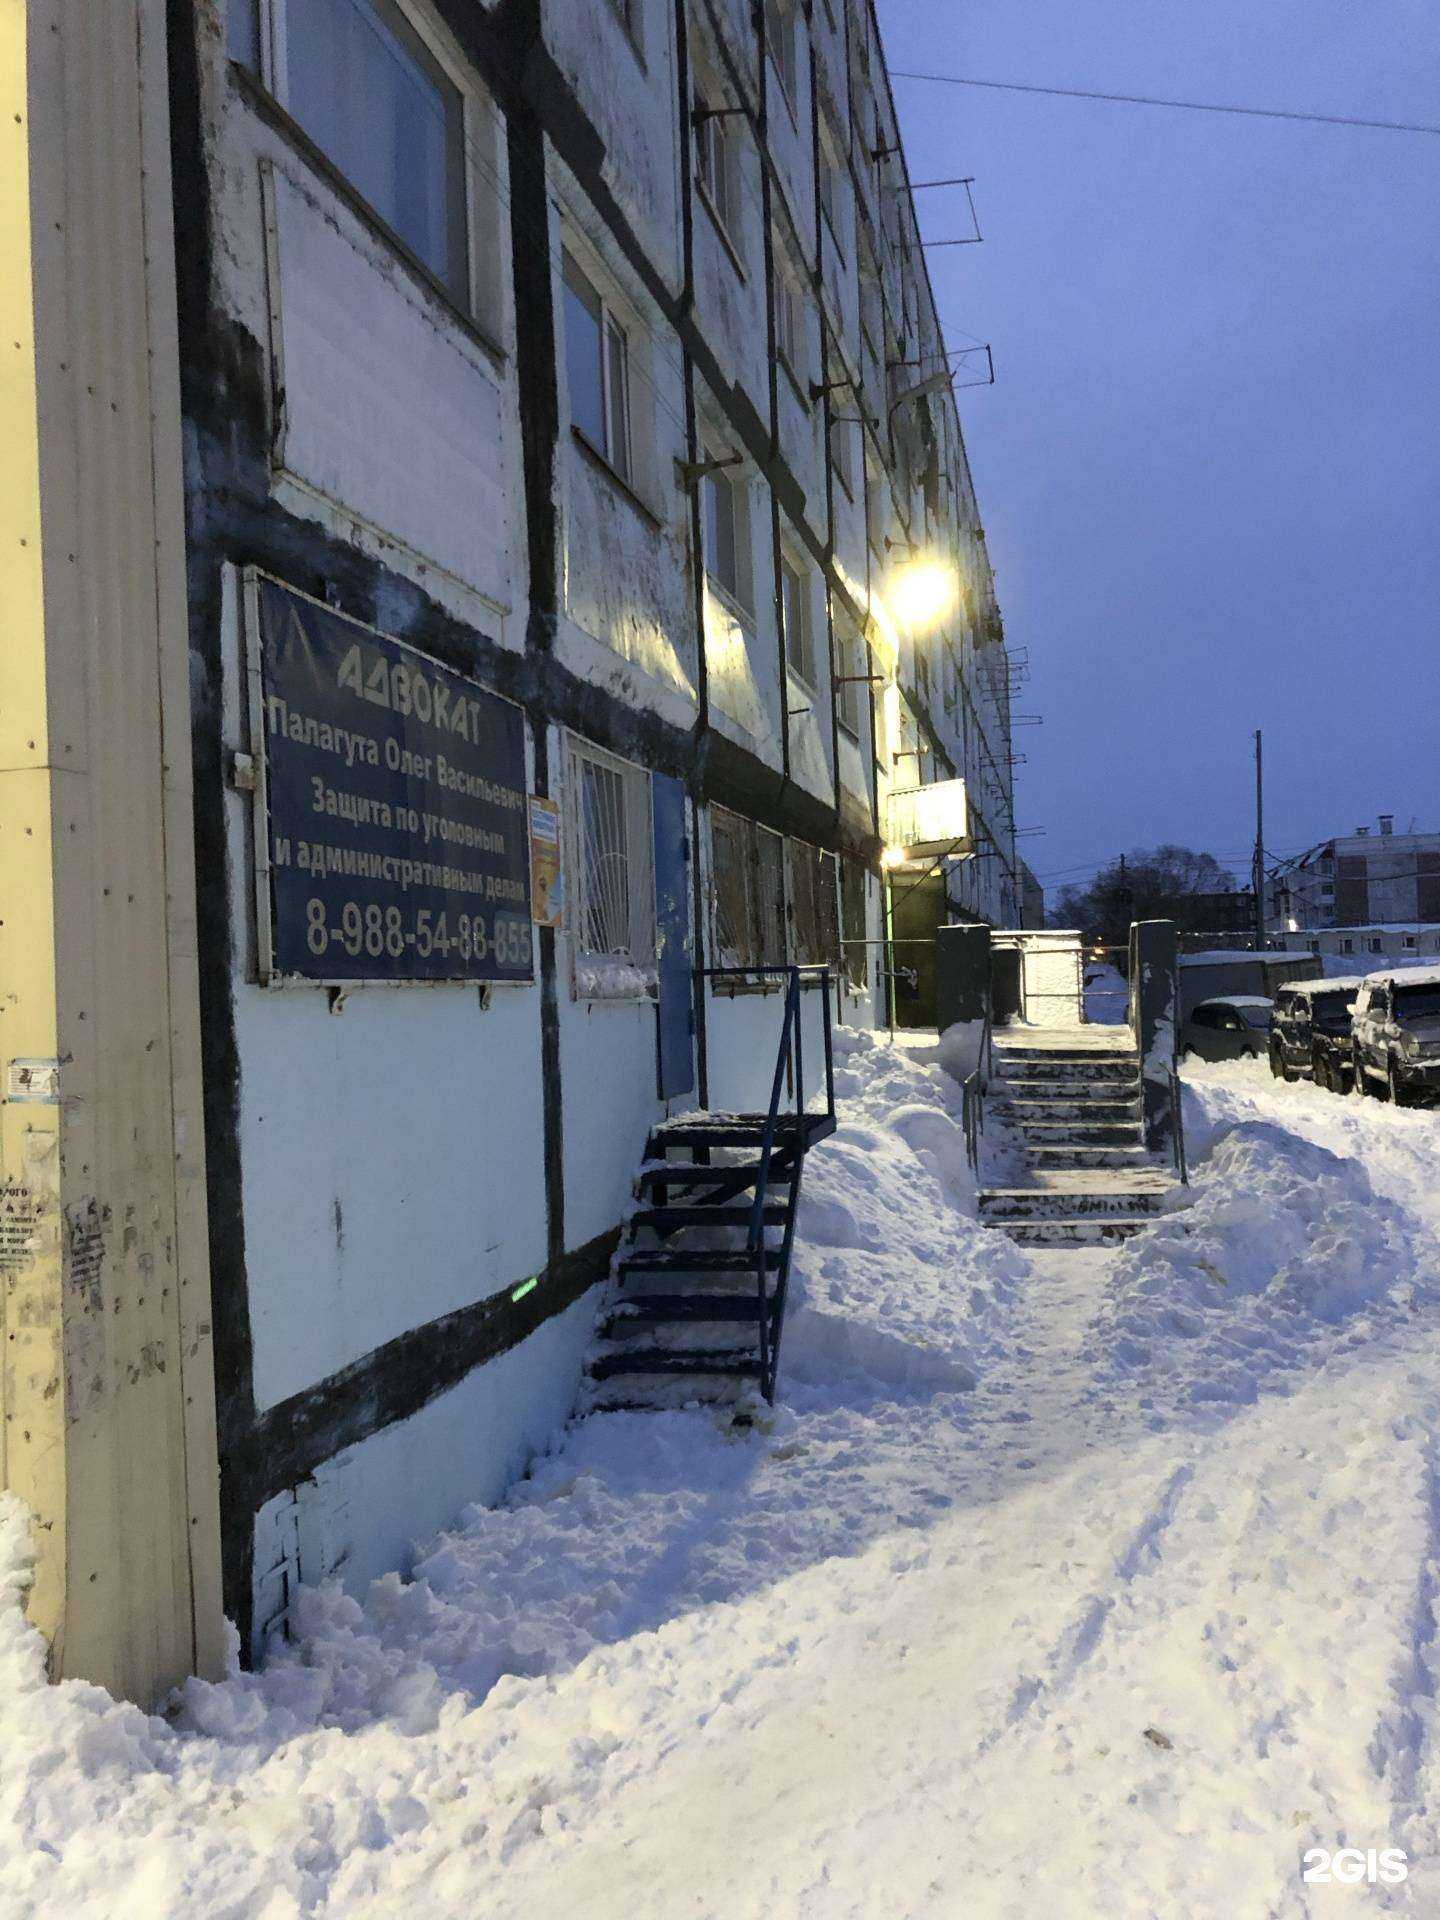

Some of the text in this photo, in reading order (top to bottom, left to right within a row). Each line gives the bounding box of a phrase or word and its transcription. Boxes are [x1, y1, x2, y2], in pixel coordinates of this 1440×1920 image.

[337, 643, 481, 746] АДВОКАТ
[268, 694, 379, 767] Палагута
[384, 737, 432, 780] Олег
[310, 776, 392, 828] Защита
[396, 806, 419, 833] по
[422, 812, 505, 855] уголовным
[297, 841, 483, 894] административным
